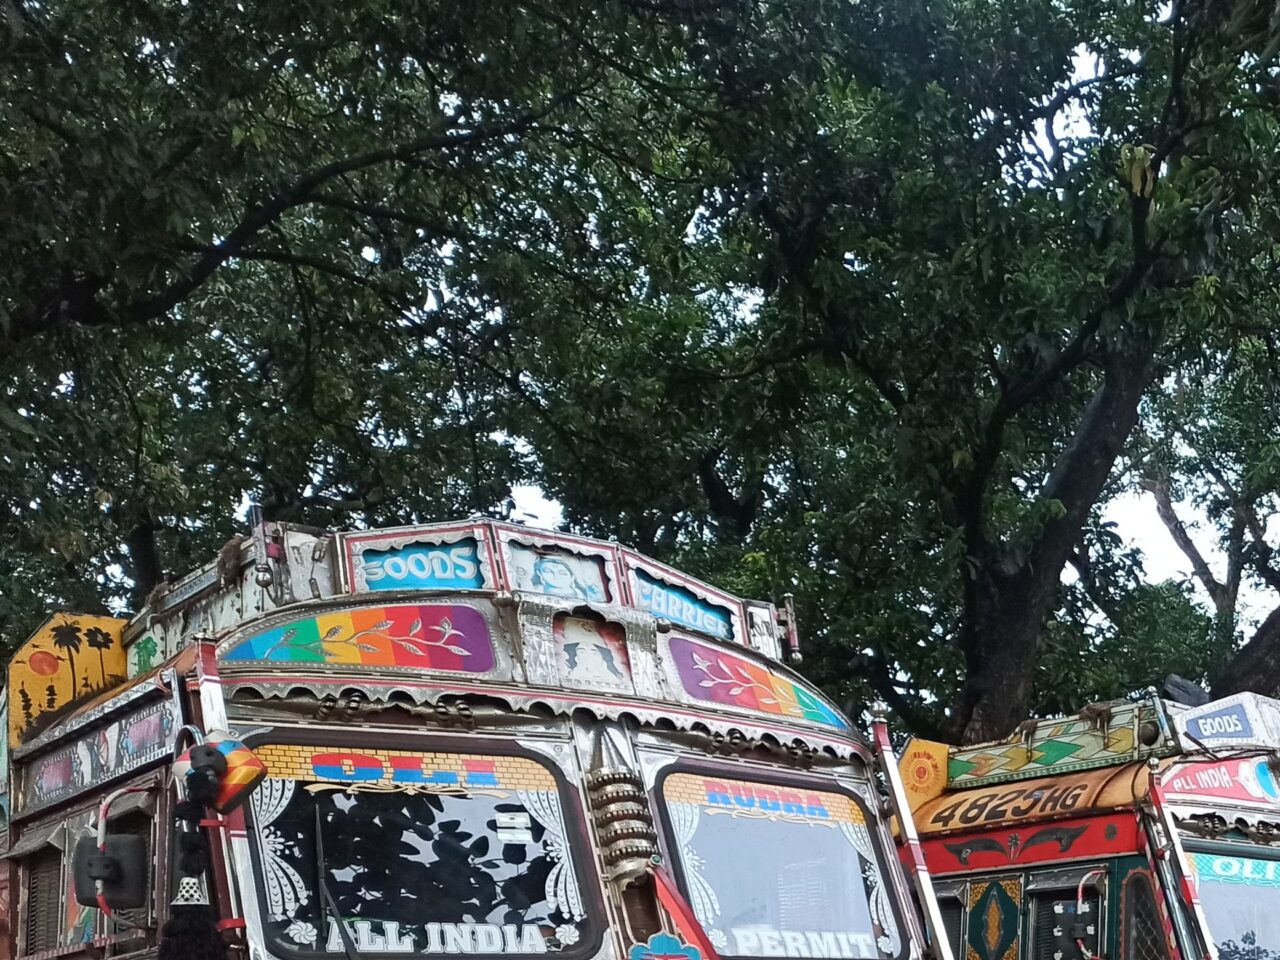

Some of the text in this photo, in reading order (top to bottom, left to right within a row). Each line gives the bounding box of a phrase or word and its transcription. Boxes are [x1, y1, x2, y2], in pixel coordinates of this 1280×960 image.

[1198, 715, 1243, 737] GOODS
[311, 753, 500, 786] OLI
[1173, 766, 1234, 791] ALL INDIA
[703, 780, 831, 818] RUDRA
[1212, 858, 1276, 880] OLI
[326, 920, 548, 954] ALL INDIA
[731, 927, 874, 958] PERMIT
